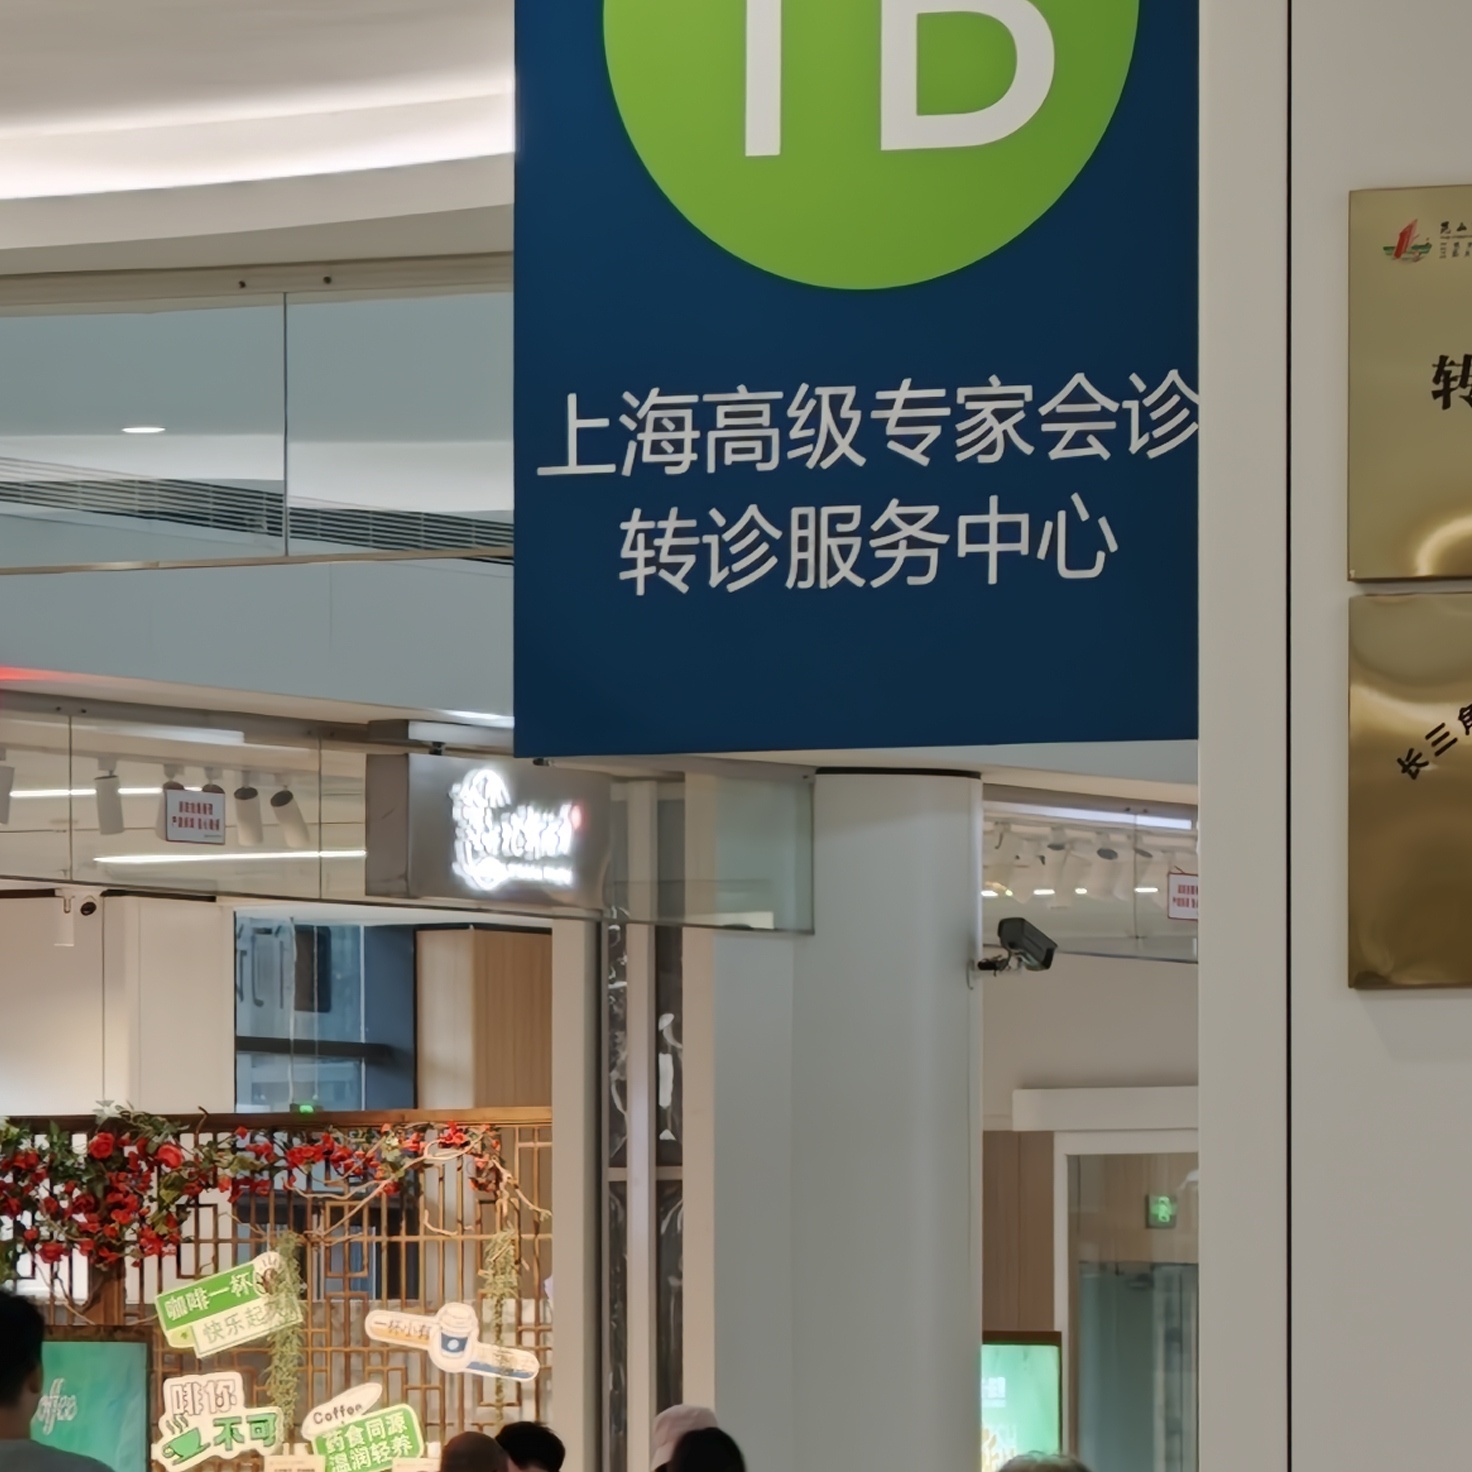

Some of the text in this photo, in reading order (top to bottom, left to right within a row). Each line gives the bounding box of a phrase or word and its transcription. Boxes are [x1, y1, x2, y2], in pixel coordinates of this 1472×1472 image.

[536, 366, 1200, 480] 上海高级专家会诊
[617, 490, 1119, 599] 转诊服务中心
[163, 1270, 254, 1321] 咖啡一杯
[169, 1378, 238, 1417] 啡你
[212, 1412, 278, 1452] 不可
